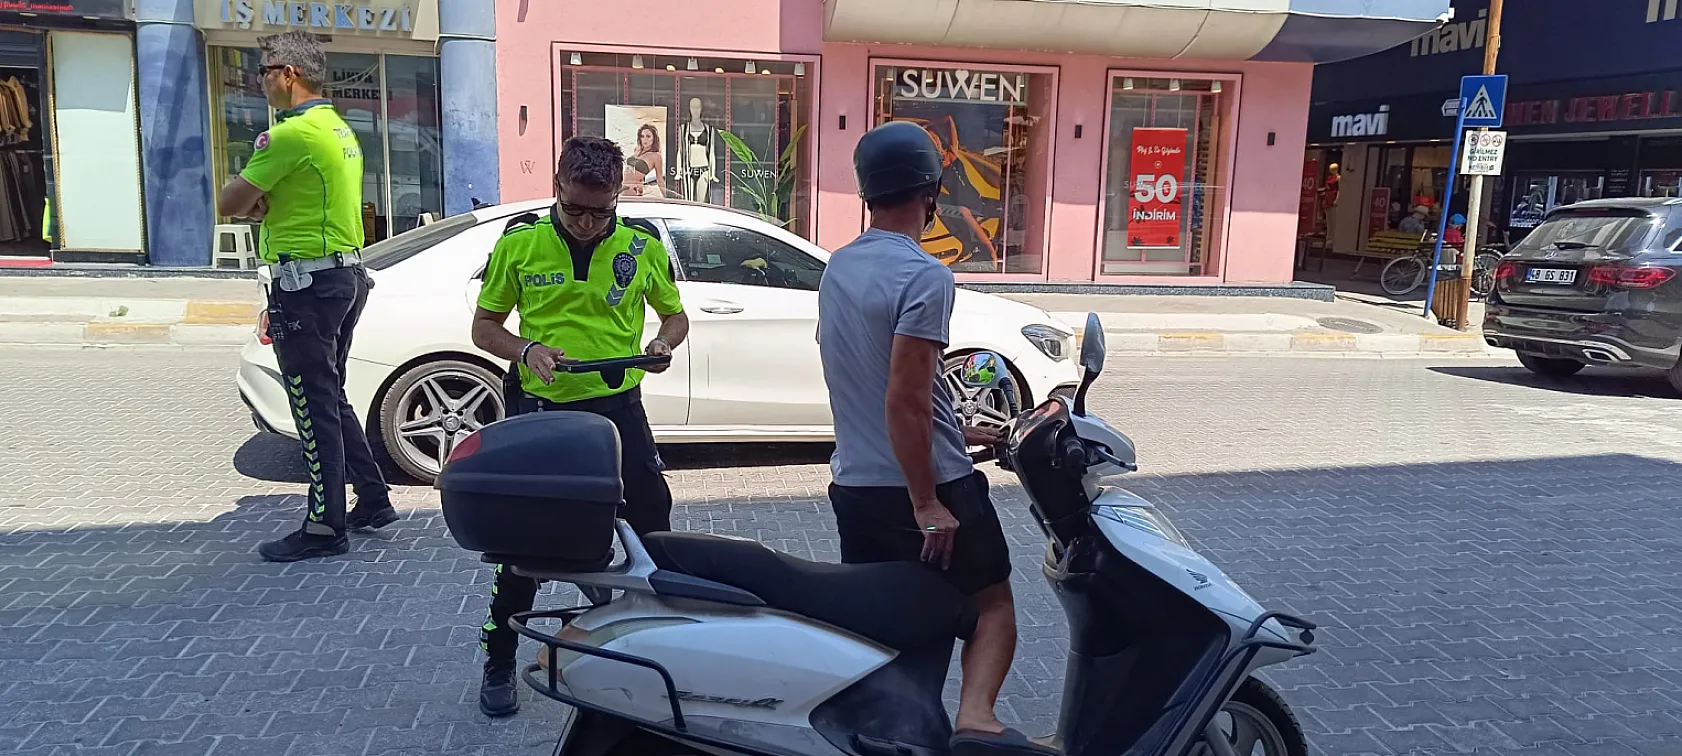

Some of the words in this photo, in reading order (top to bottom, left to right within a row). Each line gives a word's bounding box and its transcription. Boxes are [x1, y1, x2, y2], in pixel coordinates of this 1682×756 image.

[262, 1, 412, 32] MERKEZİ
[1410, 9, 1487, 57] mavi
[332, 87, 393, 100] MERKEİ
[901, 69, 1021, 102] SUWEN
[1331, 104, 1390, 137] mavi
[669, 166, 709, 176] SWEN
[741, 169, 776, 178] SUWEN
[1135, 174, 1178, 203] 50
[1132, 208, 1176, 220] İNDİRİM
[1544, 270, 1555, 280] GS
